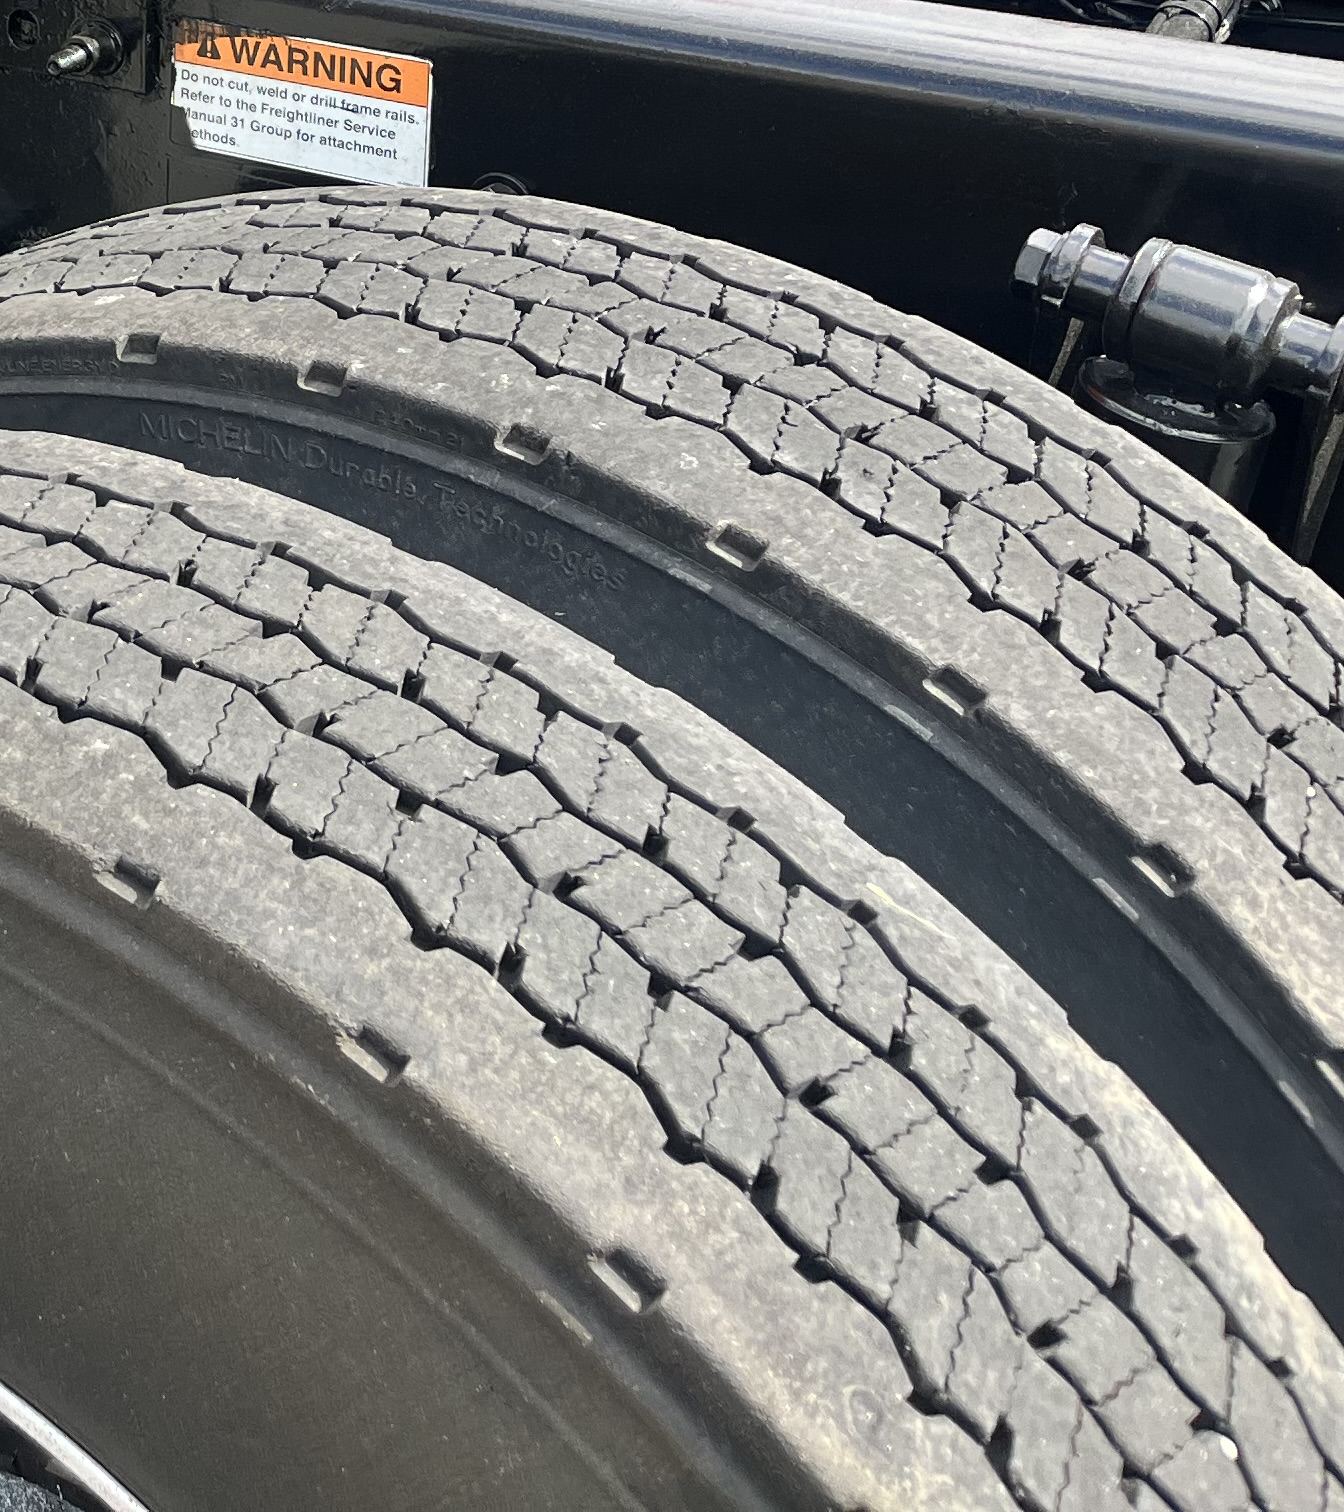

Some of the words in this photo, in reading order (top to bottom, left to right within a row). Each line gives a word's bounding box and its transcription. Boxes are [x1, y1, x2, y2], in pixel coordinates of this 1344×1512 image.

[229, 36, 402, 94] WARNING
[180, 87, 216, 104] Refer
[219, 95, 232, 108] to
[236, 98, 257, 113] the
[260, 102, 340, 129] Freightliner
[343, 119, 396, 140] Service
[181, 69, 199, 83] Do
[203, 75, 224, 88] not
[228, 80, 252, 95] cut,
[256, 84, 288, 100] weld
[292, 92, 307, 103] or
[310, 94, 337, 108] drill
[340, 99, 382, 118] frame
[385, 110, 420, 126] rails.
[190, 128, 241, 147] ethods.
[230, 116, 245, 129] 31
[250, 120, 293, 140] Group
[296, 129, 315, 143] for
[319, 136, 398, 160] attachment
[138, 411, 293, 464] MICHELIN
[302, 438, 419, 500] Durable
[432, 479, 629, 593] Technologies
